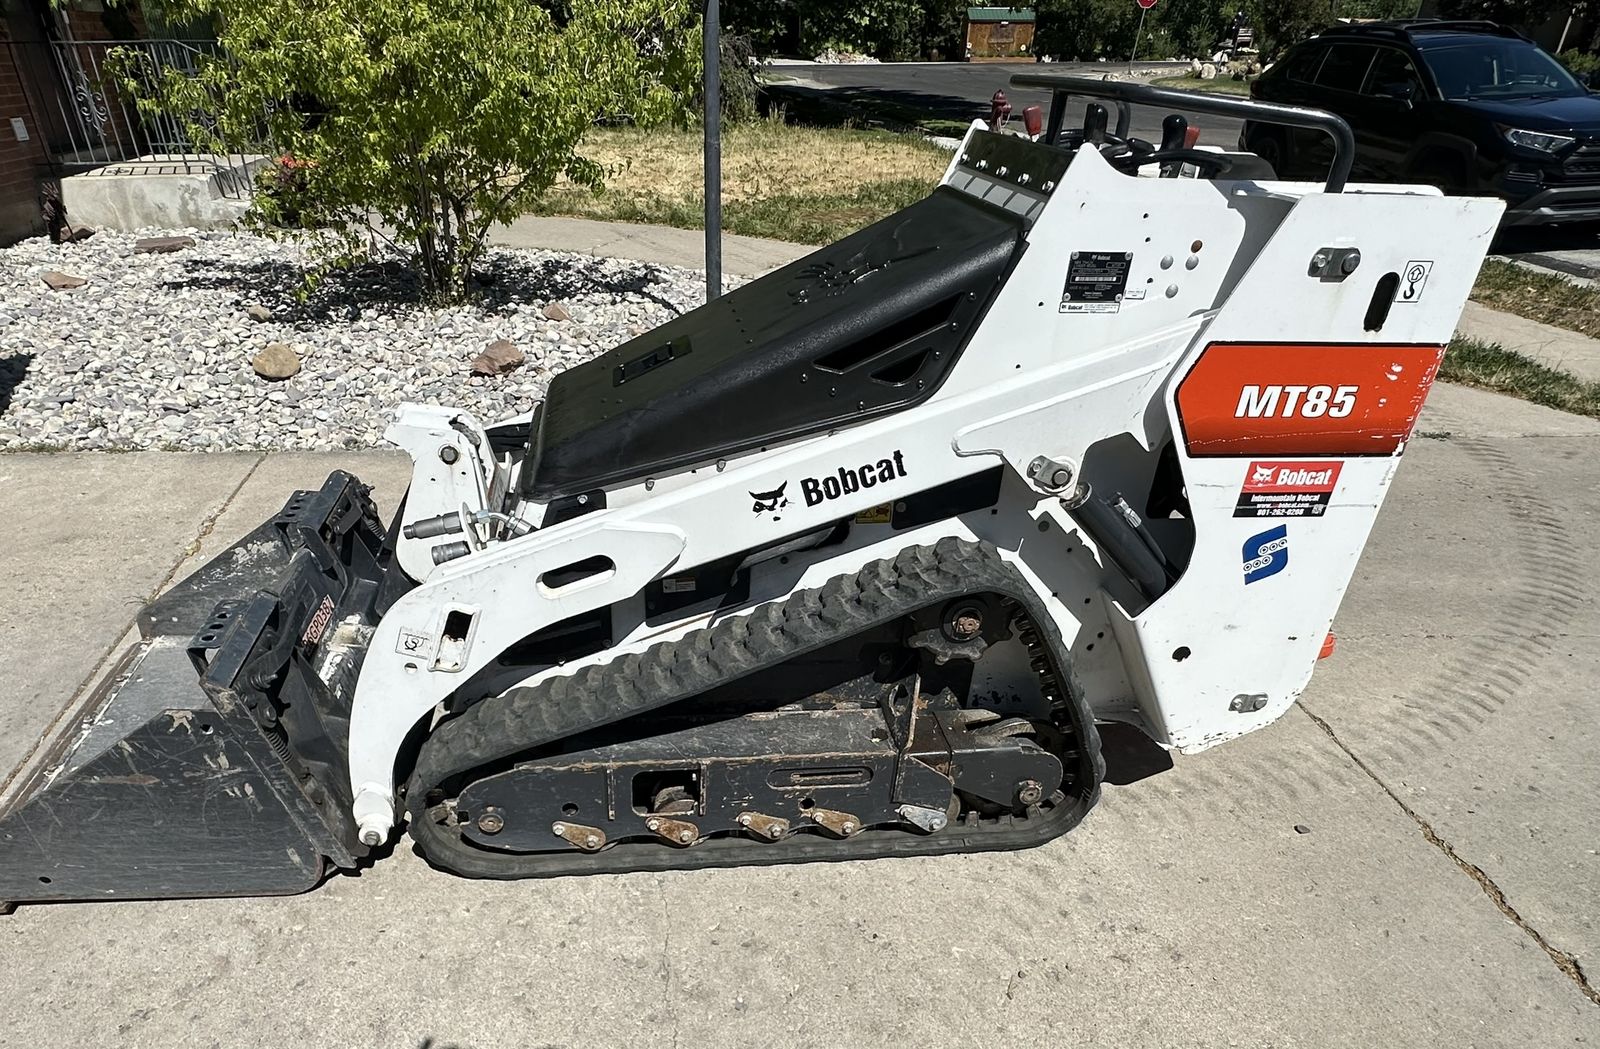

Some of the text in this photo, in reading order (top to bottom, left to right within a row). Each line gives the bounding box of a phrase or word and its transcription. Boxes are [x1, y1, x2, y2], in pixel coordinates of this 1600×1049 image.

[1234, 384, 1360, 418] MT85
[800, 450, 908, 507] Bobcat
[1276, 468, 1332, 486] Bobcat
[1297, 494, 1320, 502] Bobcat
